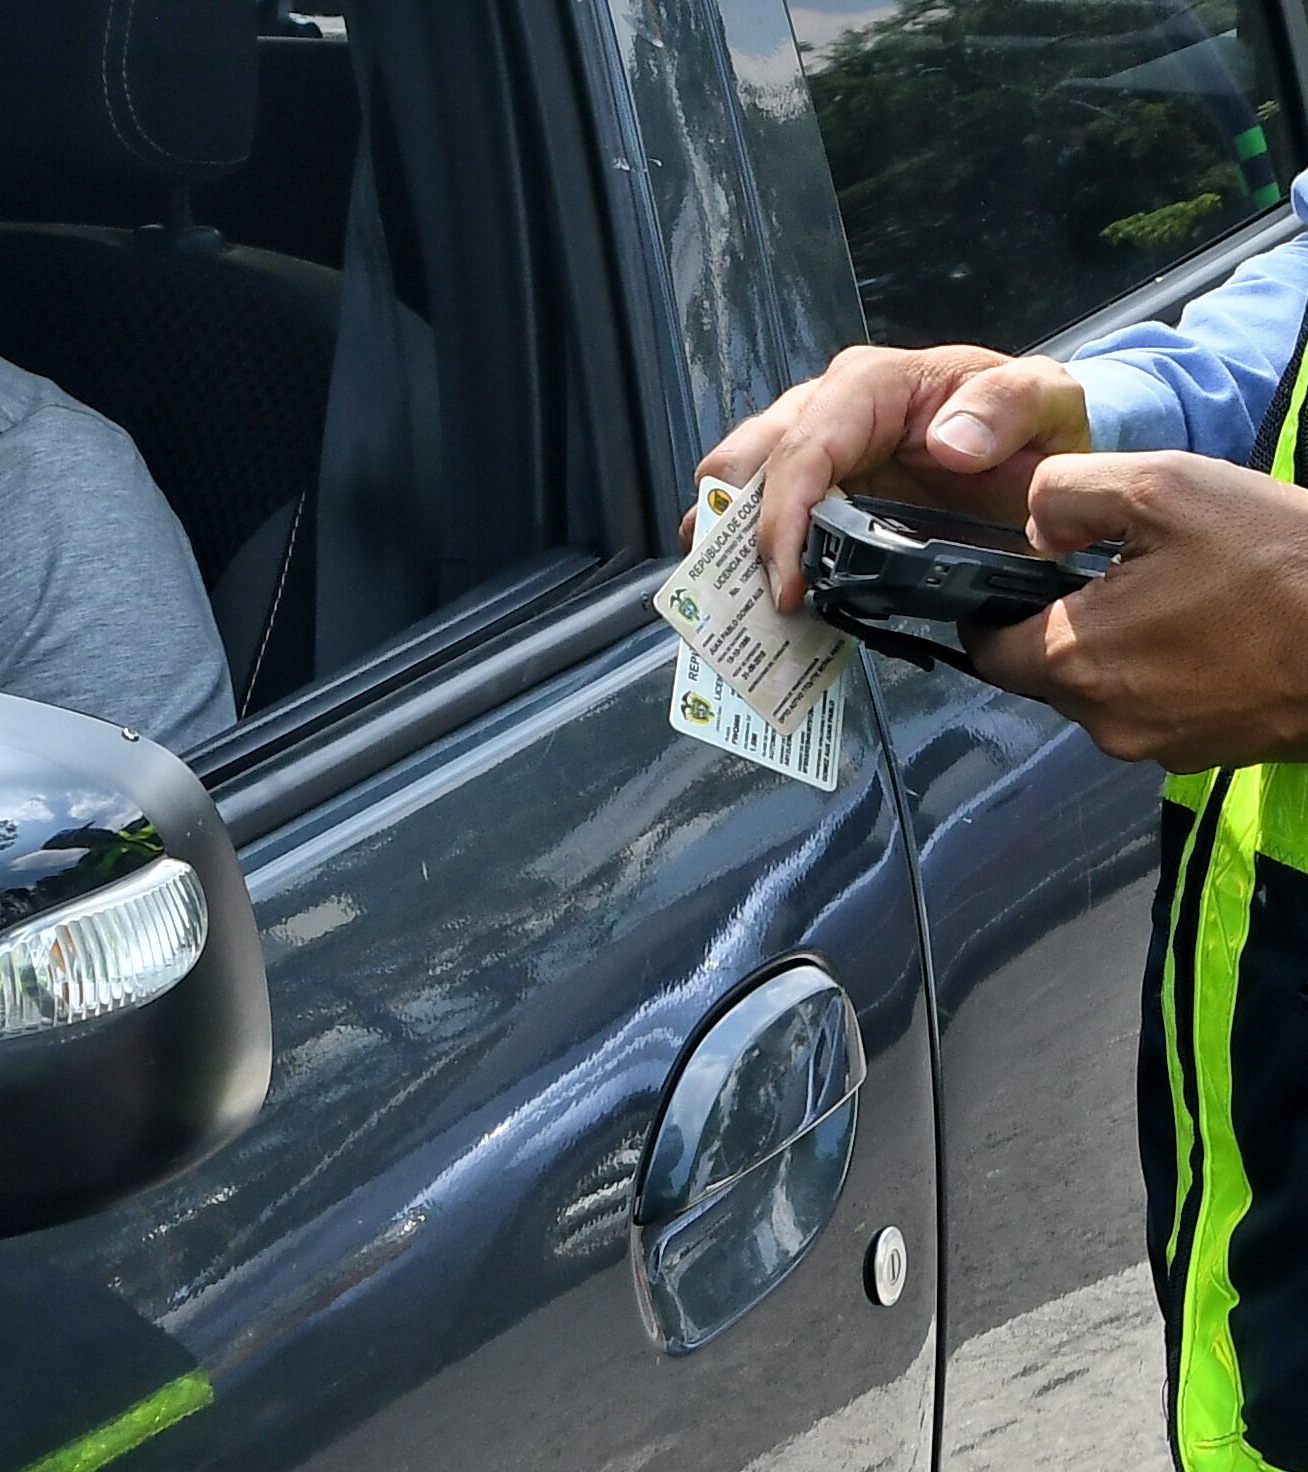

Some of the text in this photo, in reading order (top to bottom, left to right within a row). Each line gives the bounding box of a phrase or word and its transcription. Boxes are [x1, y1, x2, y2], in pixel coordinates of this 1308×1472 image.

[688, 531, 731, 581] REPÚBLICA
[726, 517, 741, 534] DE
[713, 554, 743, 590] LICENCIA
[739, 544, 752, 558] DE
